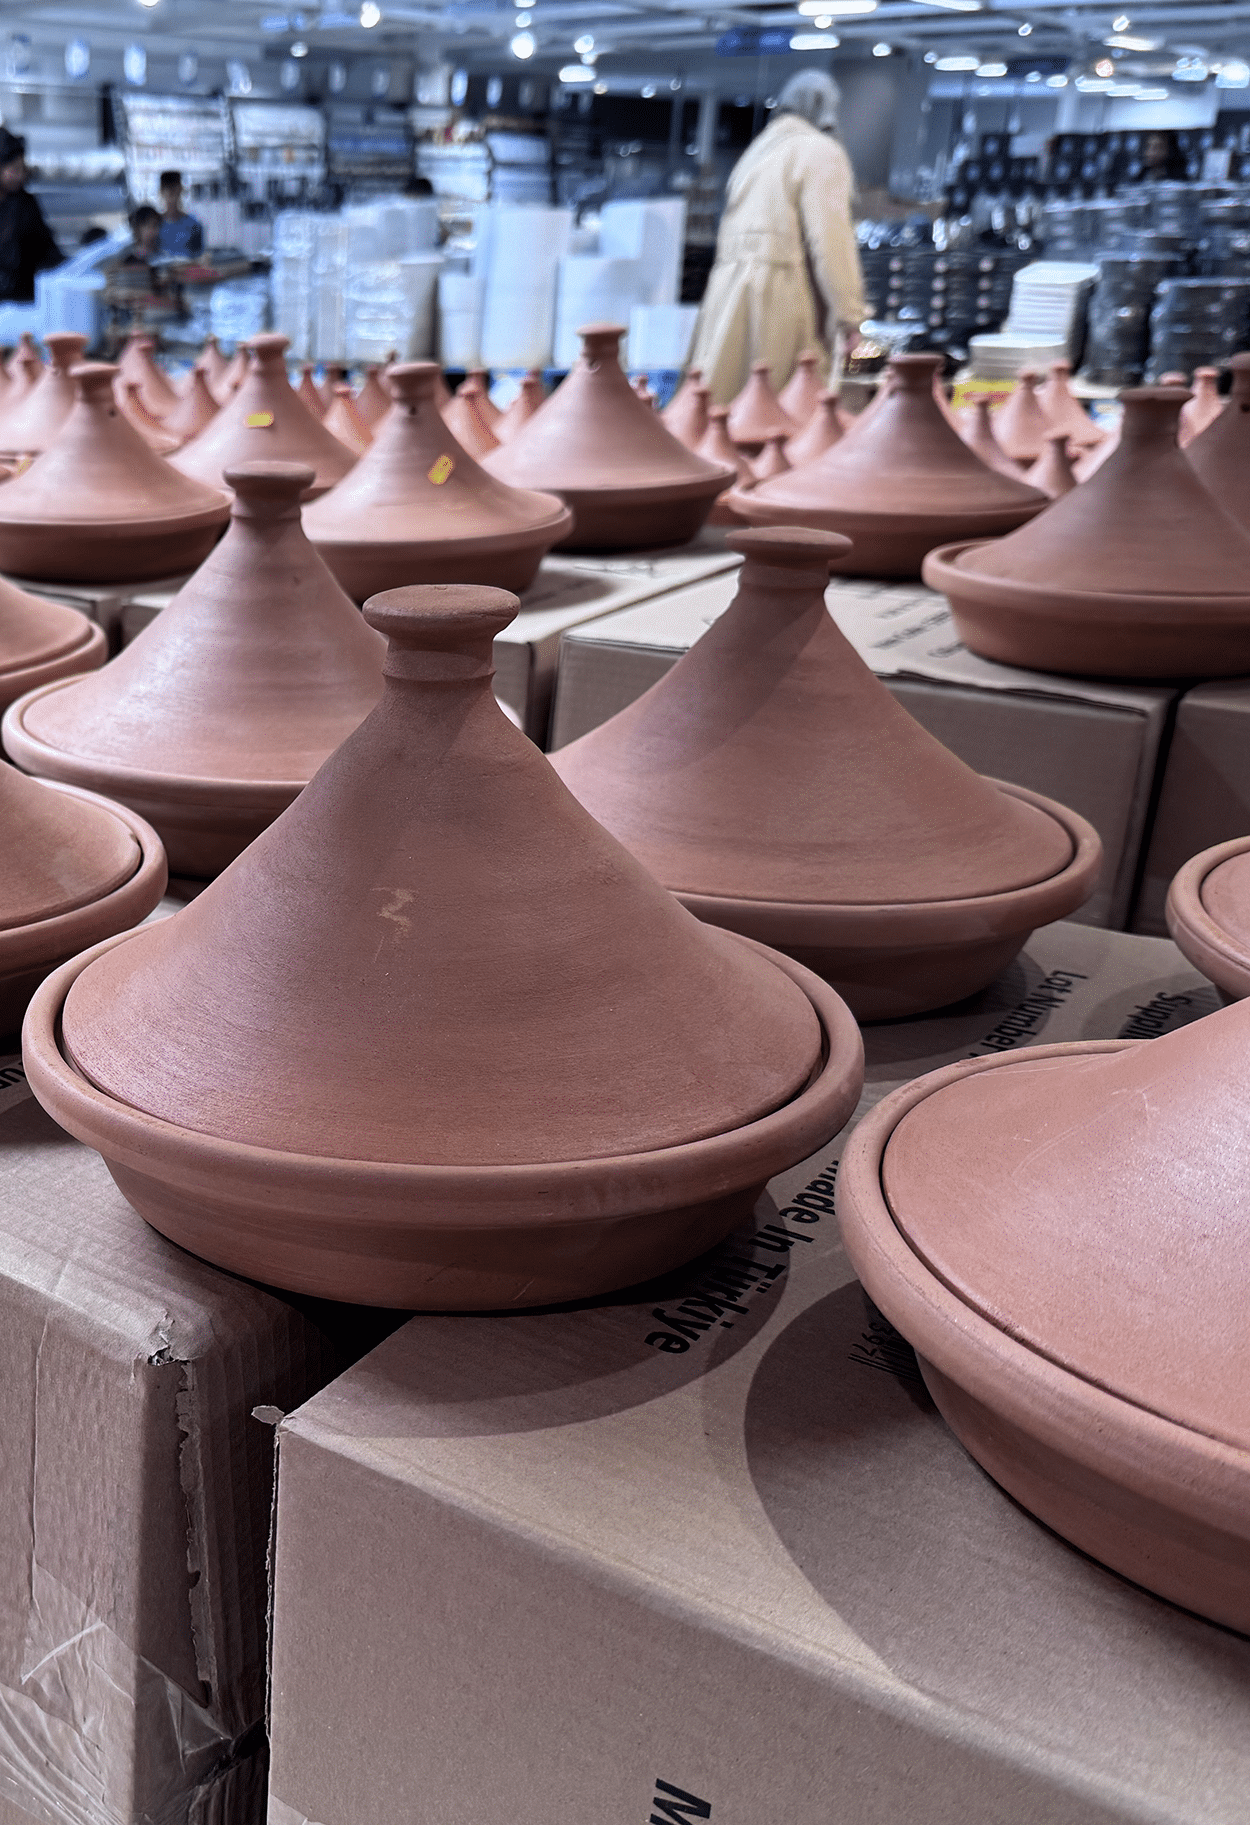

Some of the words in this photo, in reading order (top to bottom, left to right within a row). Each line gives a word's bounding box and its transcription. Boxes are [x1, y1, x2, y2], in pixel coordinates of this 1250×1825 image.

[1038, 970, 1088, 994] Lot
[980, 991, 1066, 1051] Number
[750, 1224, 815, 1253] In
[643, 1256, 787, 1354] Türkiye
